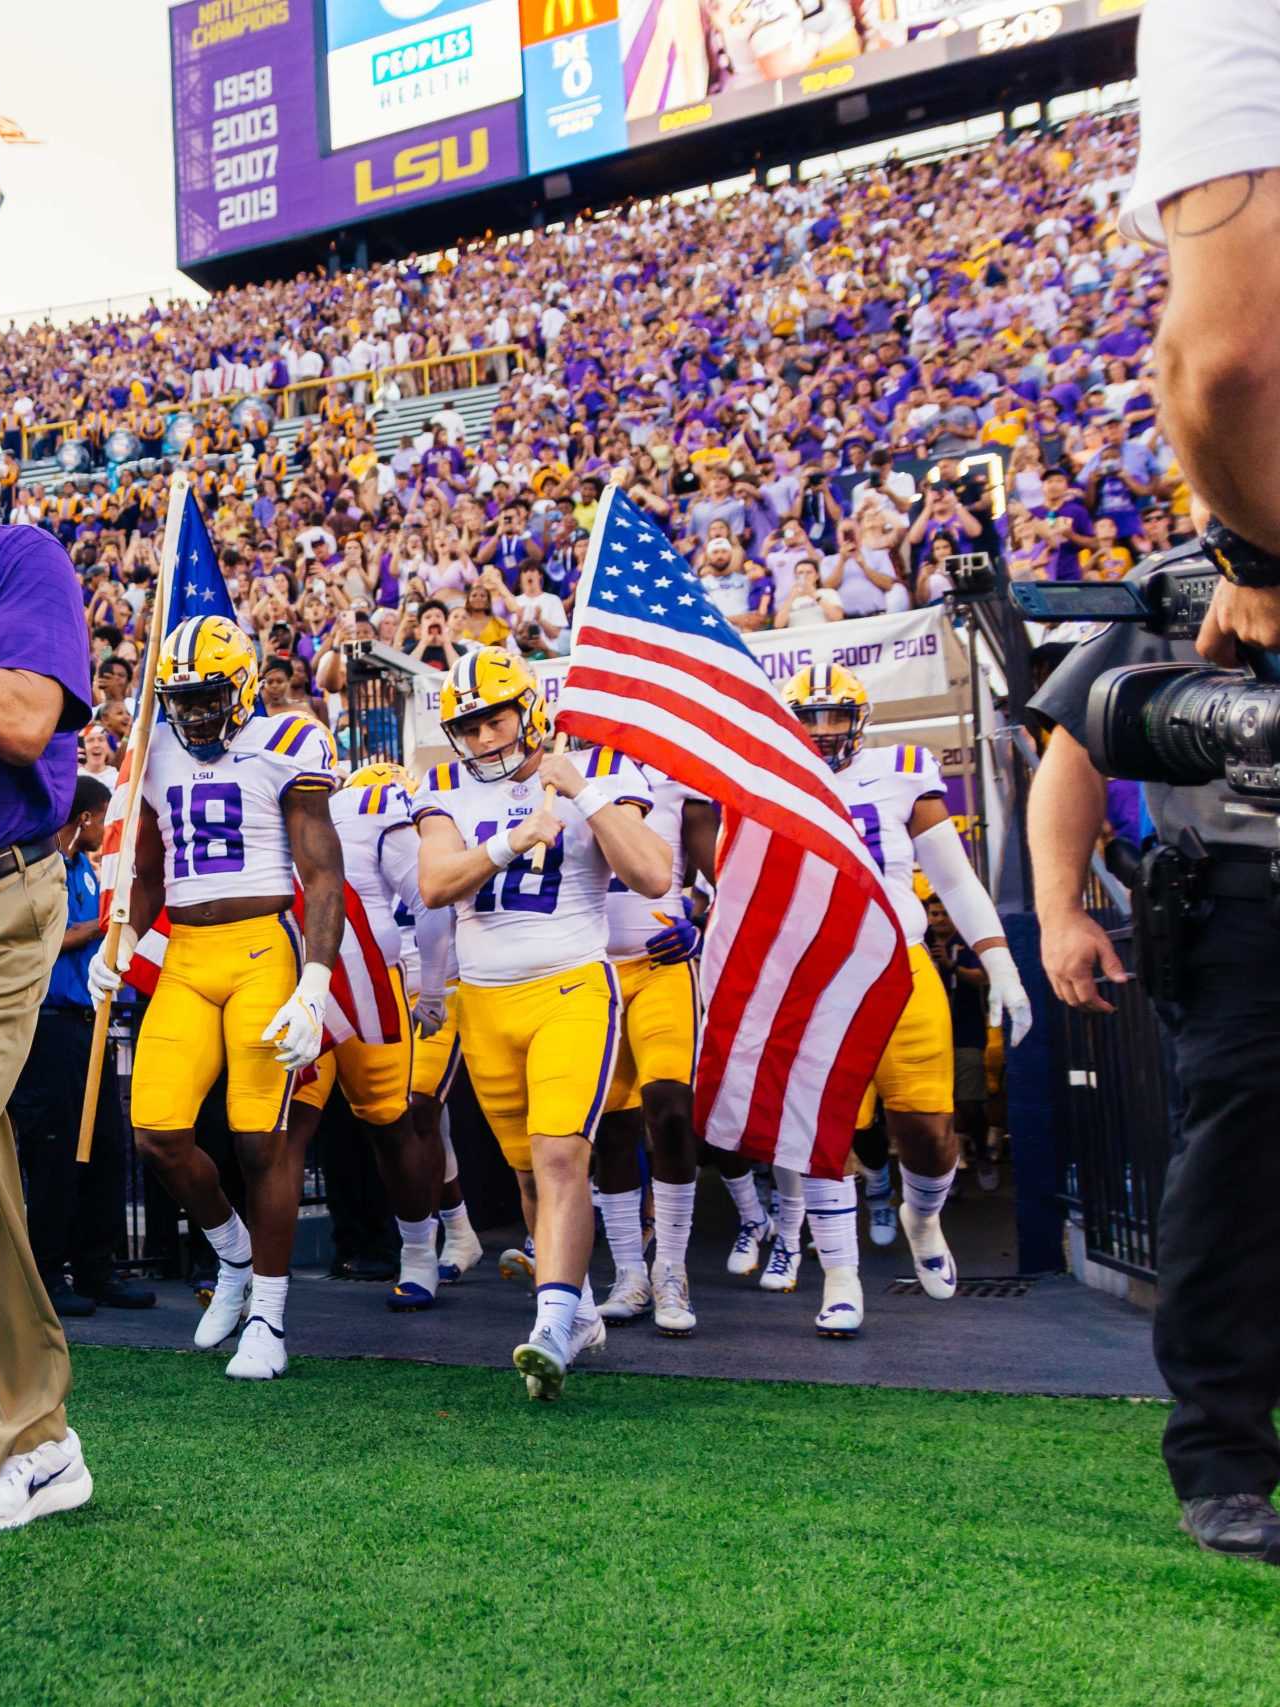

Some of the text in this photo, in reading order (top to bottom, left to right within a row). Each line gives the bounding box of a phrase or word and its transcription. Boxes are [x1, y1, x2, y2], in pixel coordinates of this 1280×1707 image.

[375, 28, 471, 82] PEOPLES
[213, 66, 273, 112] 1958
[380, 67, 470, 108] HEALTH
[213, 104, 279, 152] 2003
[214, 144, 279, 192] 2007
[355, 127, 490, 206] LSU
[218, 186, 278, 231] 2019
[832, 643, 884, 669] 2007
[894, 633, 937, 661] 2019
[173, 672, 190, 682] LSU
[192, 771, 214, 780] LSU
[167, 782, 245, 879] 18
[507, 807, 533, 816] LSU
